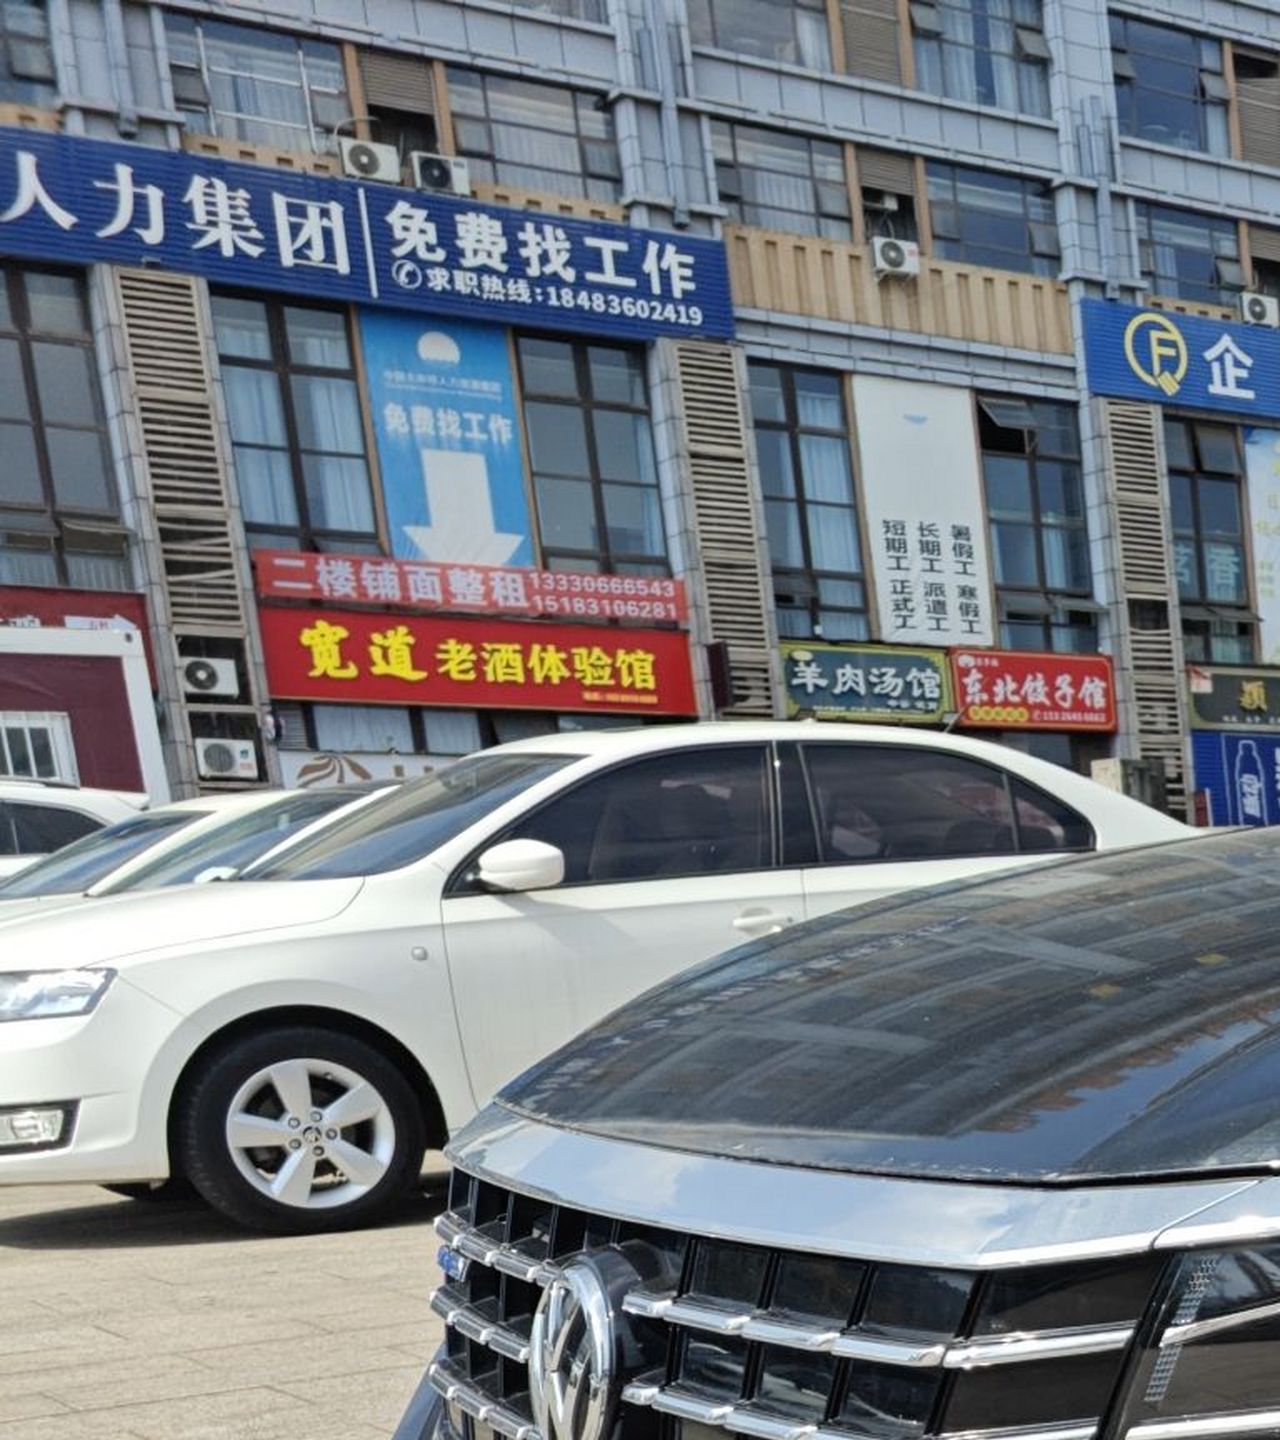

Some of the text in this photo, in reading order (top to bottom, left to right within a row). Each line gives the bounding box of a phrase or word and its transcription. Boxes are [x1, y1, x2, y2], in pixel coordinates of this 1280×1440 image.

[0, 151, 696, 300] 人力集团 免费找工作
[383, 402, 513, 445] 免费找工作
[917, 520, 944, 573] 长期工
[273, 557, 675, 608] 二楼铺面整租 13330666543
[882, 519, 917, 629] 短期工 正式工
[532, 594, 677, 618] 15183106281
[301, 620, 657, 690] 宽道 老酒体验馆
[791, 661, 940, 699] 羊肉汤馆
[962, 668, 1107, 709] 东北饺子馆
